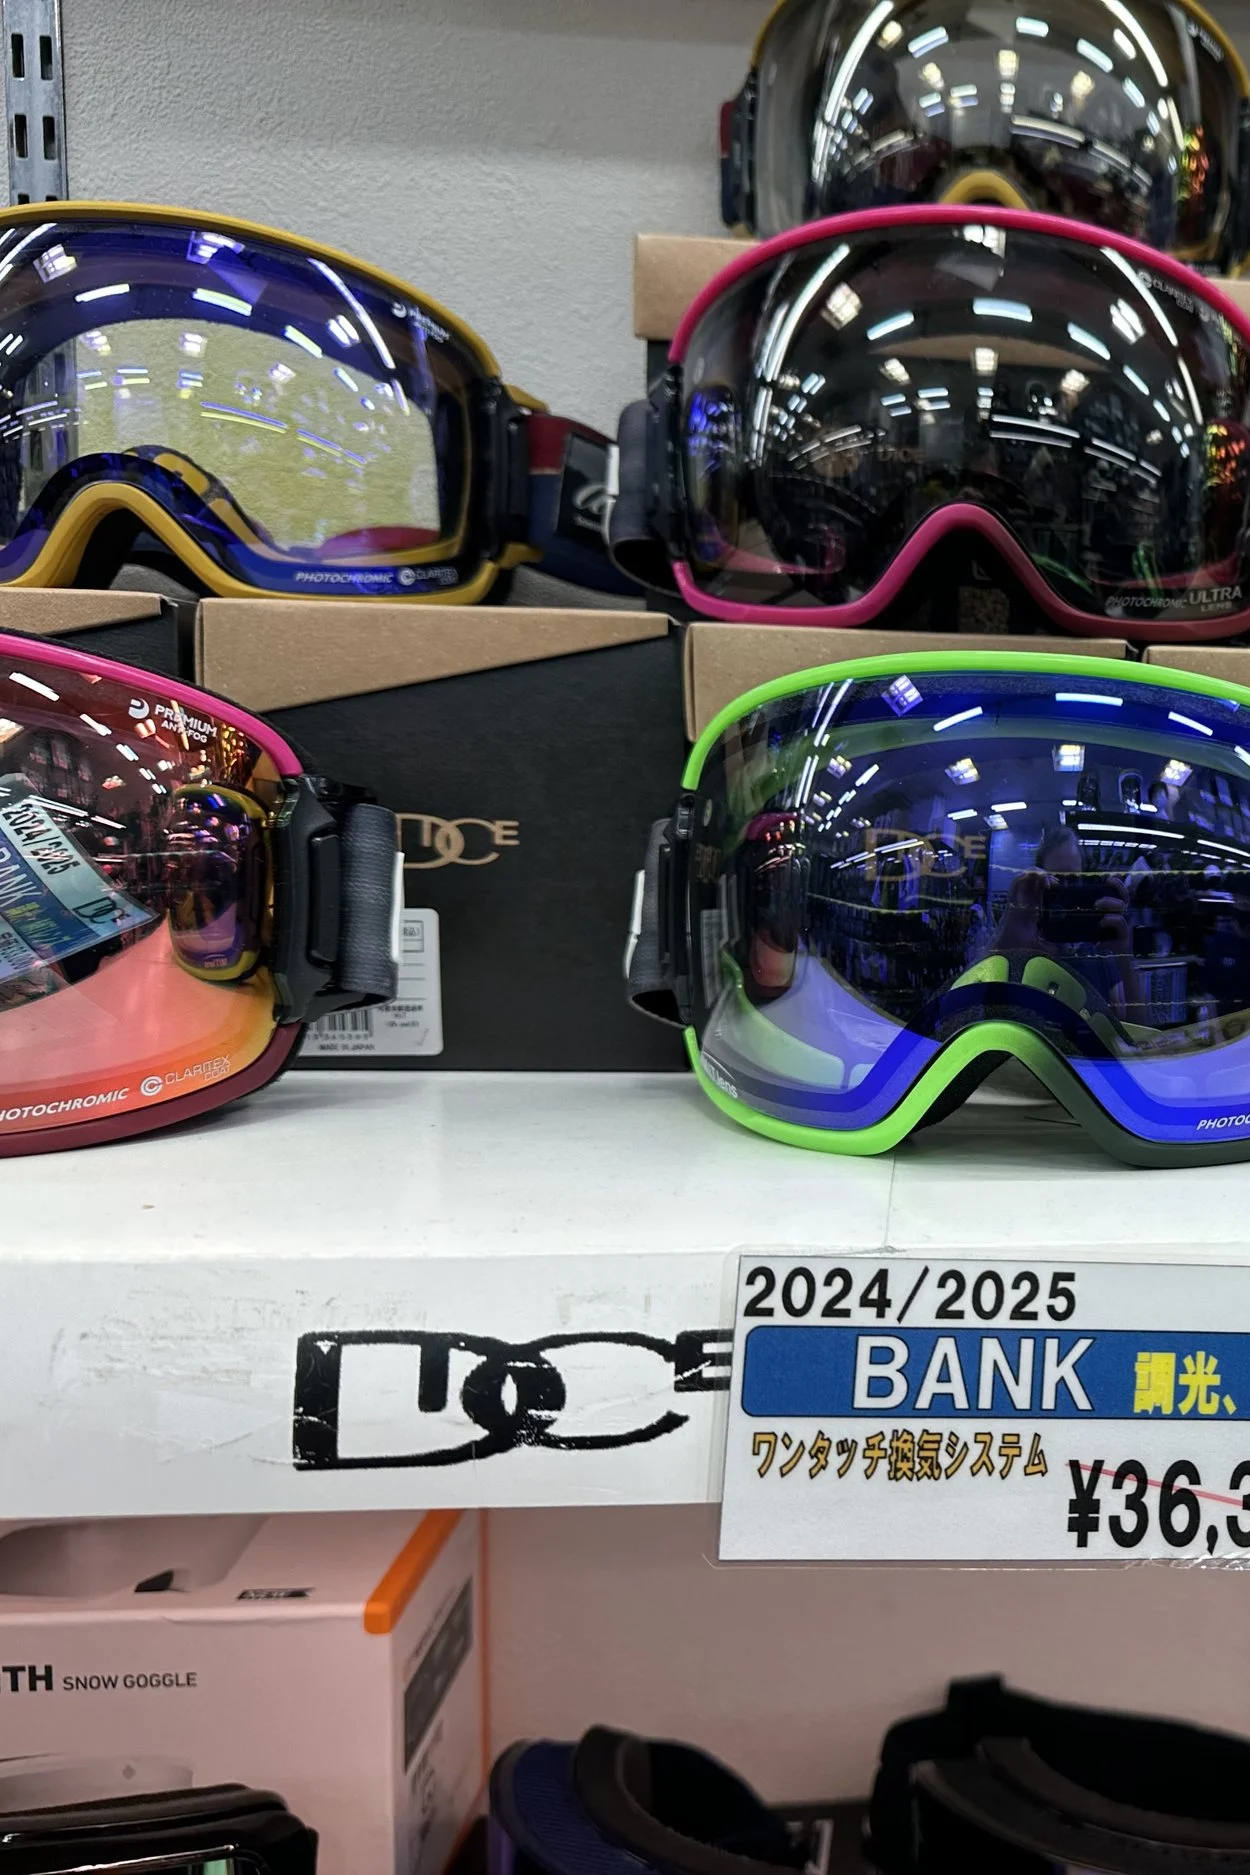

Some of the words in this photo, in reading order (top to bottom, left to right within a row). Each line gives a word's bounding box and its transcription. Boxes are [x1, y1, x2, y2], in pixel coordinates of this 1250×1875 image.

[295, 571, 394, 584] PHOTOCHROMIC
[1104, 595, 1187, 609] PHOTOCHROMIC
[1189, 586, 1243, 605] ULTRA
[1200, 601, 1233, 613] LENS
[155, 704, 218, 738] PREMIUM
[395, 812, 521, 869] DICE
[165, 1055, 231, 1085] CLARITEX
[203, 1064, 231, 1082] COAT
[743, 1265, 1076, 1323] 2024/2025
[852, 1334, 1096, 1411] BANK
[751, 1428, 1049, 1482] ワンタッチ換気システム
[0, 1664, 54, 1692] TH
[62, 1674, 119, 1692] SNOW
[123, 1671, 198, 1690] GOGGLE
